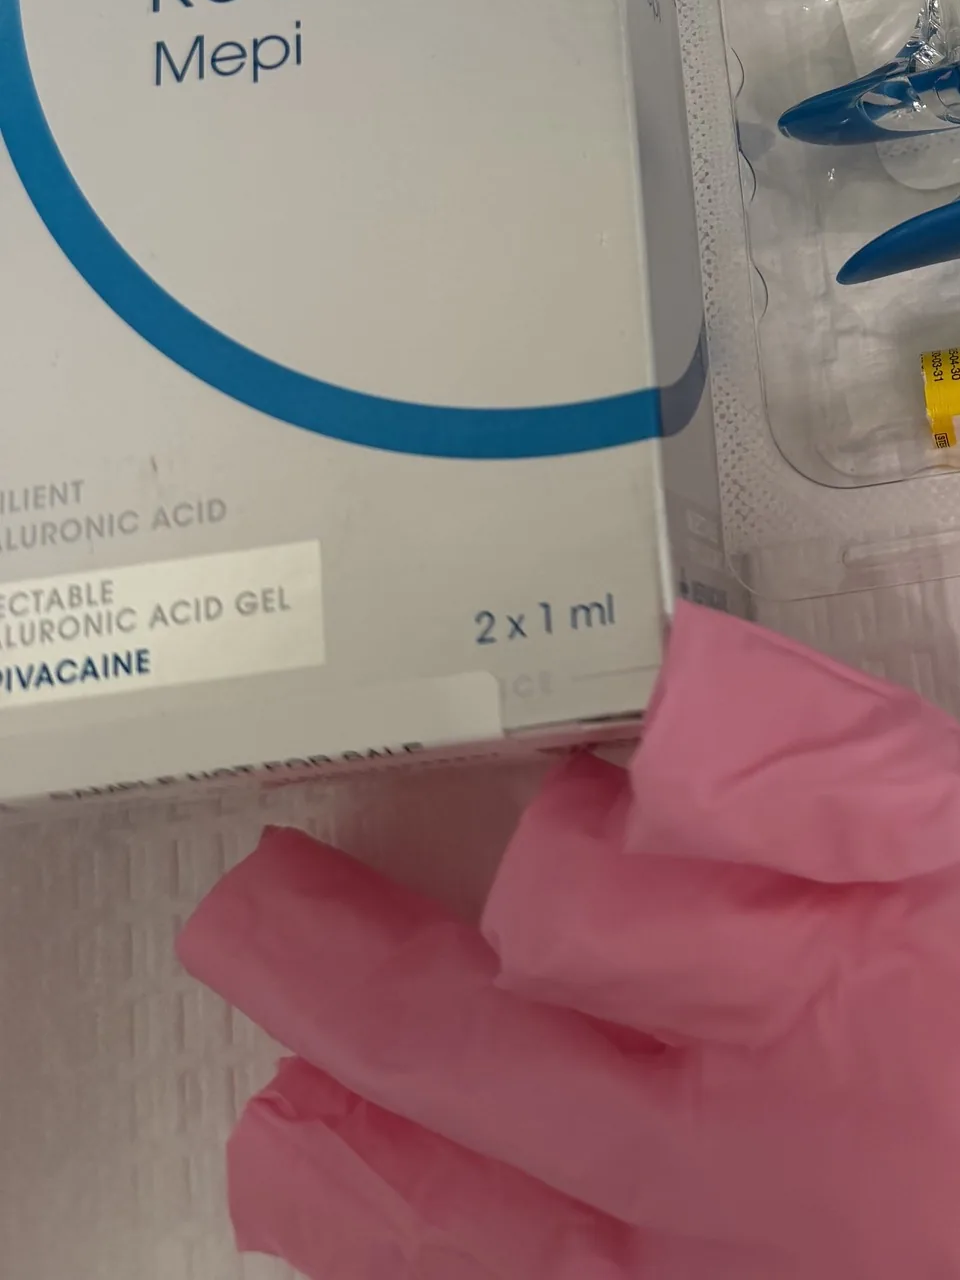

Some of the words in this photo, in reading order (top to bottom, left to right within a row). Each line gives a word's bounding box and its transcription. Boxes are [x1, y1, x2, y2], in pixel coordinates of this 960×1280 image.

[154, 20, 302, 87] Mepi
[0, 510, 139, 552] LURONIC
[152, 497, 227, 532] ACID
[0, 607, 137, 650] LURONIC
[149, 595, 223, 630] ACID
[234, 585, 291, 618] GEL
[474, 610, 499, 646] 2
[507, 611, 528, 640] x
[539, 601, 554, 636] 1
[570, 592, 616, 631] ml
